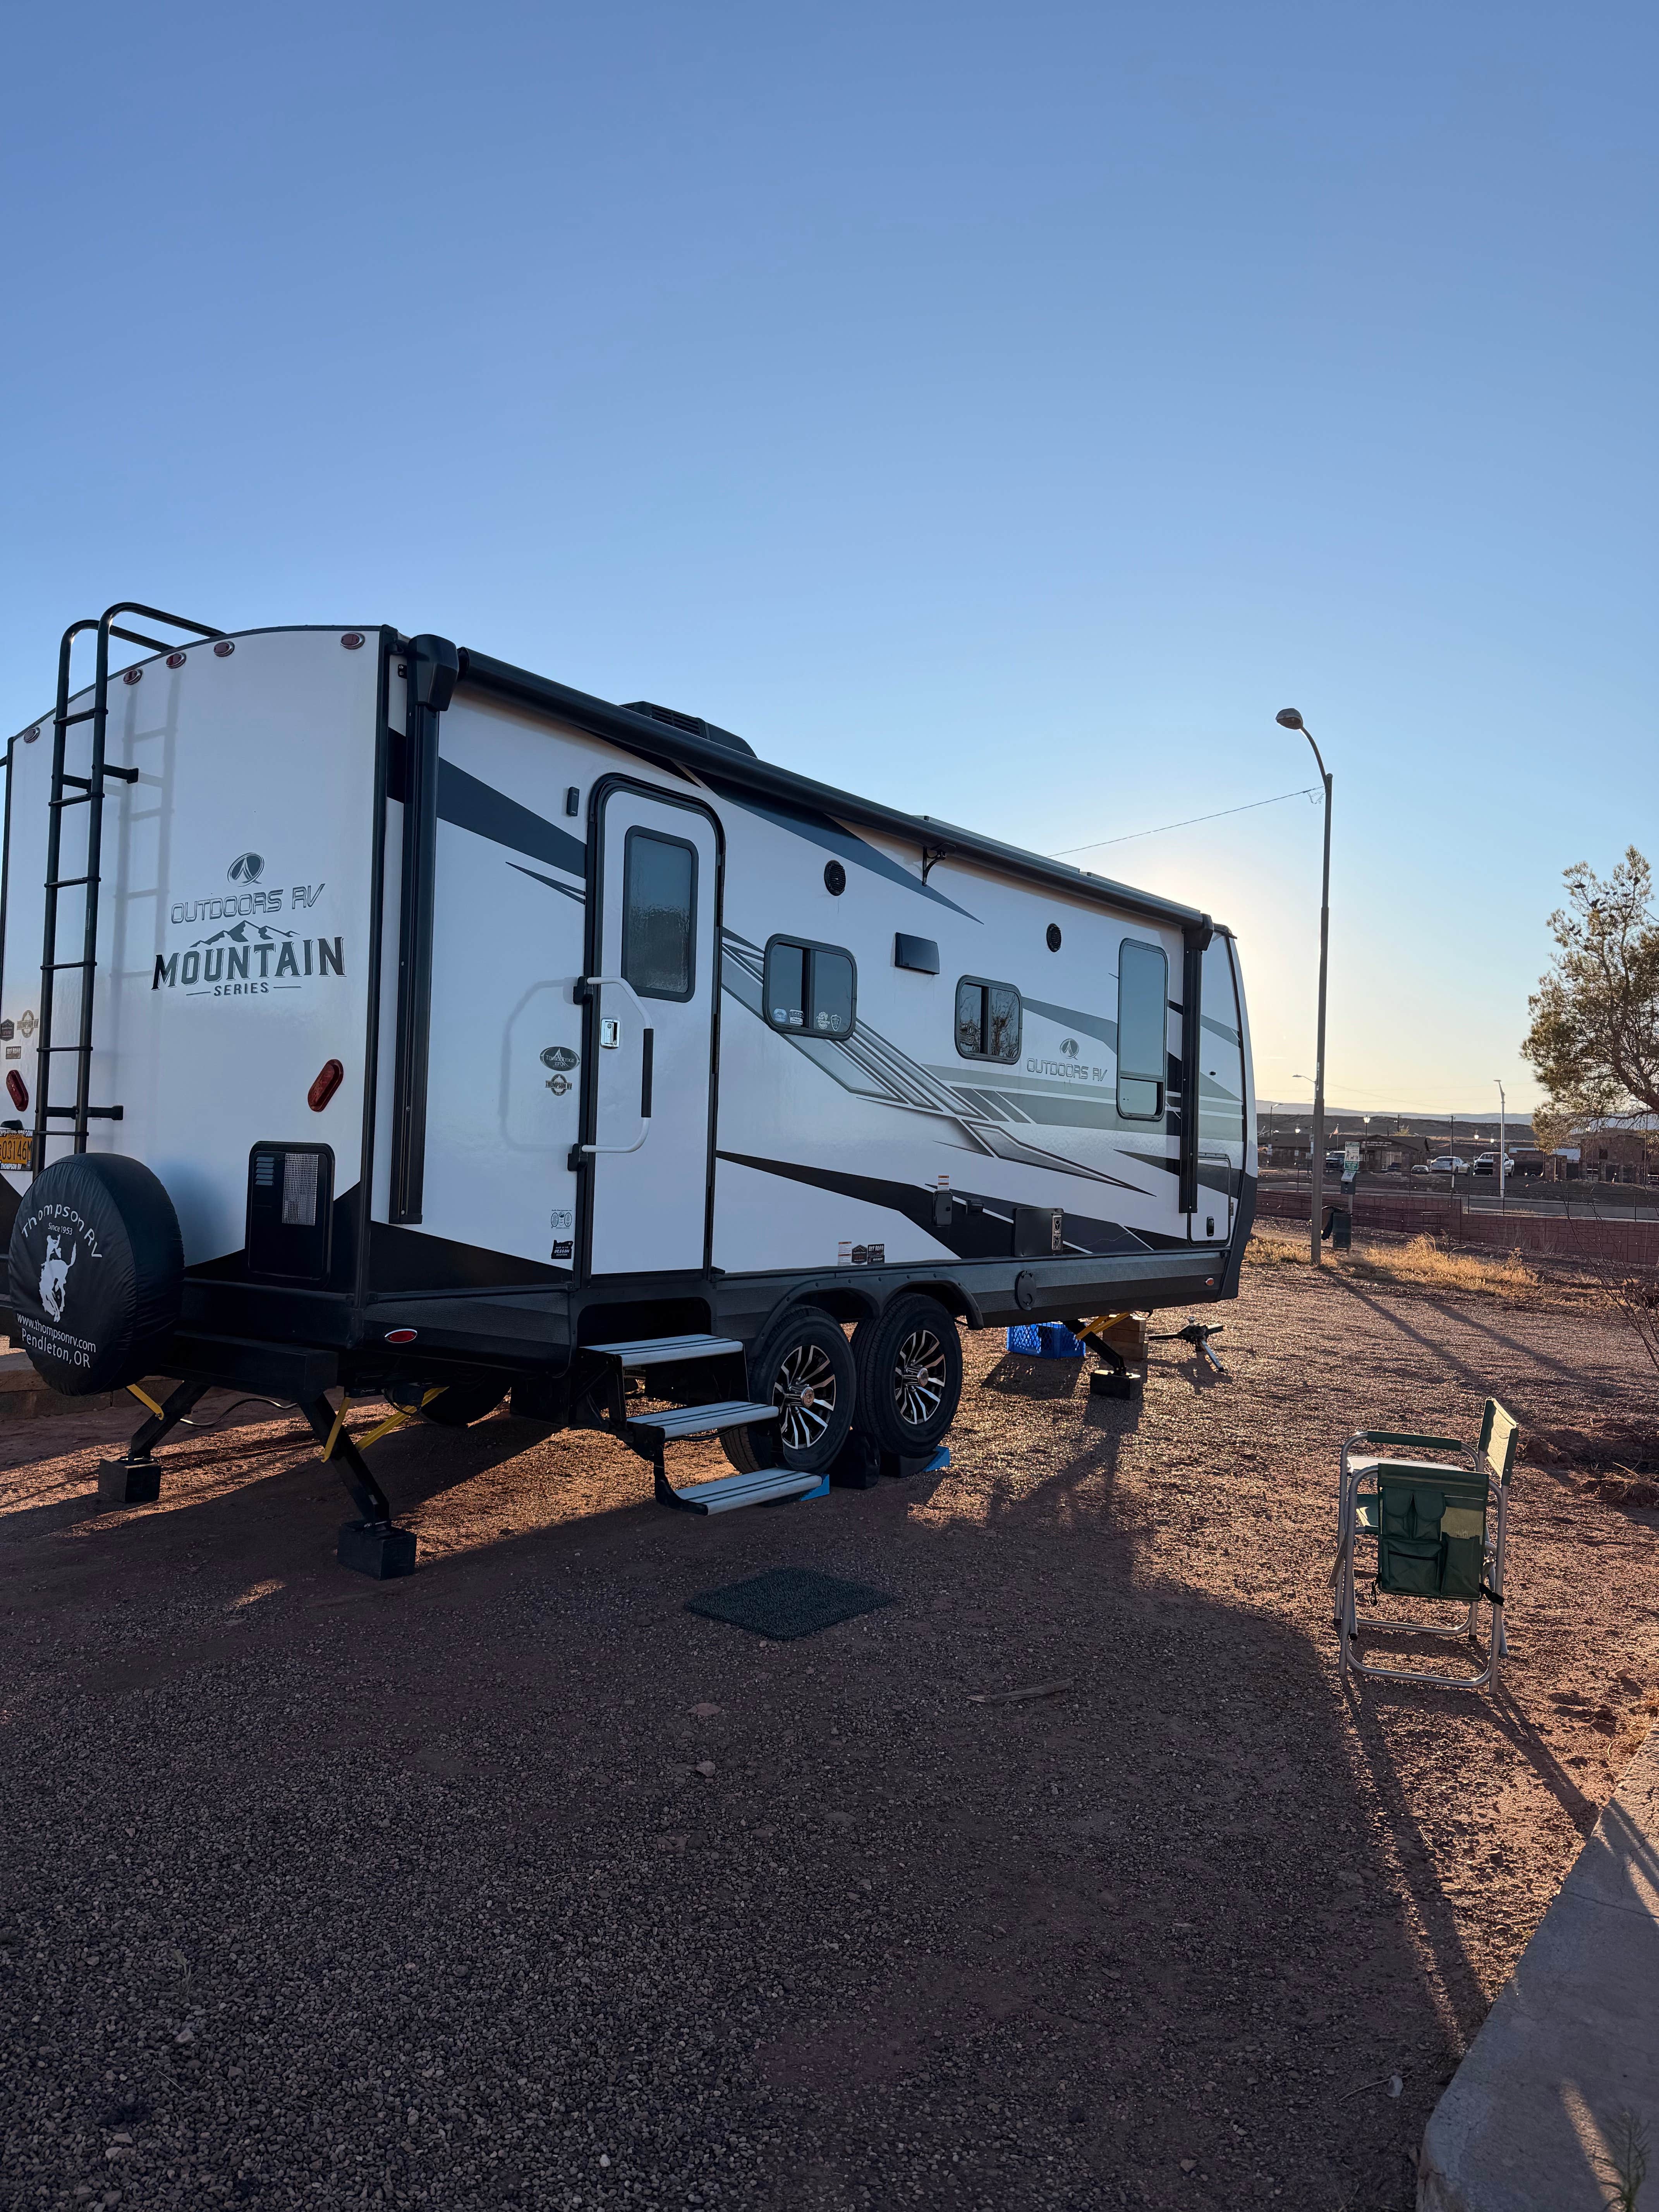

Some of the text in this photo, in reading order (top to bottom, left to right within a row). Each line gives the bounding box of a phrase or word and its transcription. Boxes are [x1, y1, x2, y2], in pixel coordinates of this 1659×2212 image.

[171, 883, 325, 924] OUTDOORS RV
[151, 936, 347, 991] MOUNTAIN
[214, 982, 270, 996] SERIES
[1027, 1058, 1108, 1081] OUTDOORS RV
[22, 1204, 103, 1258] Thompson RV
[48, 1222, 73, 1235] Since 1953
[17, 1313, 96, 1353] www.thompsonrv.com
[22, 1328, 91, 1368] Pendleton, OR
